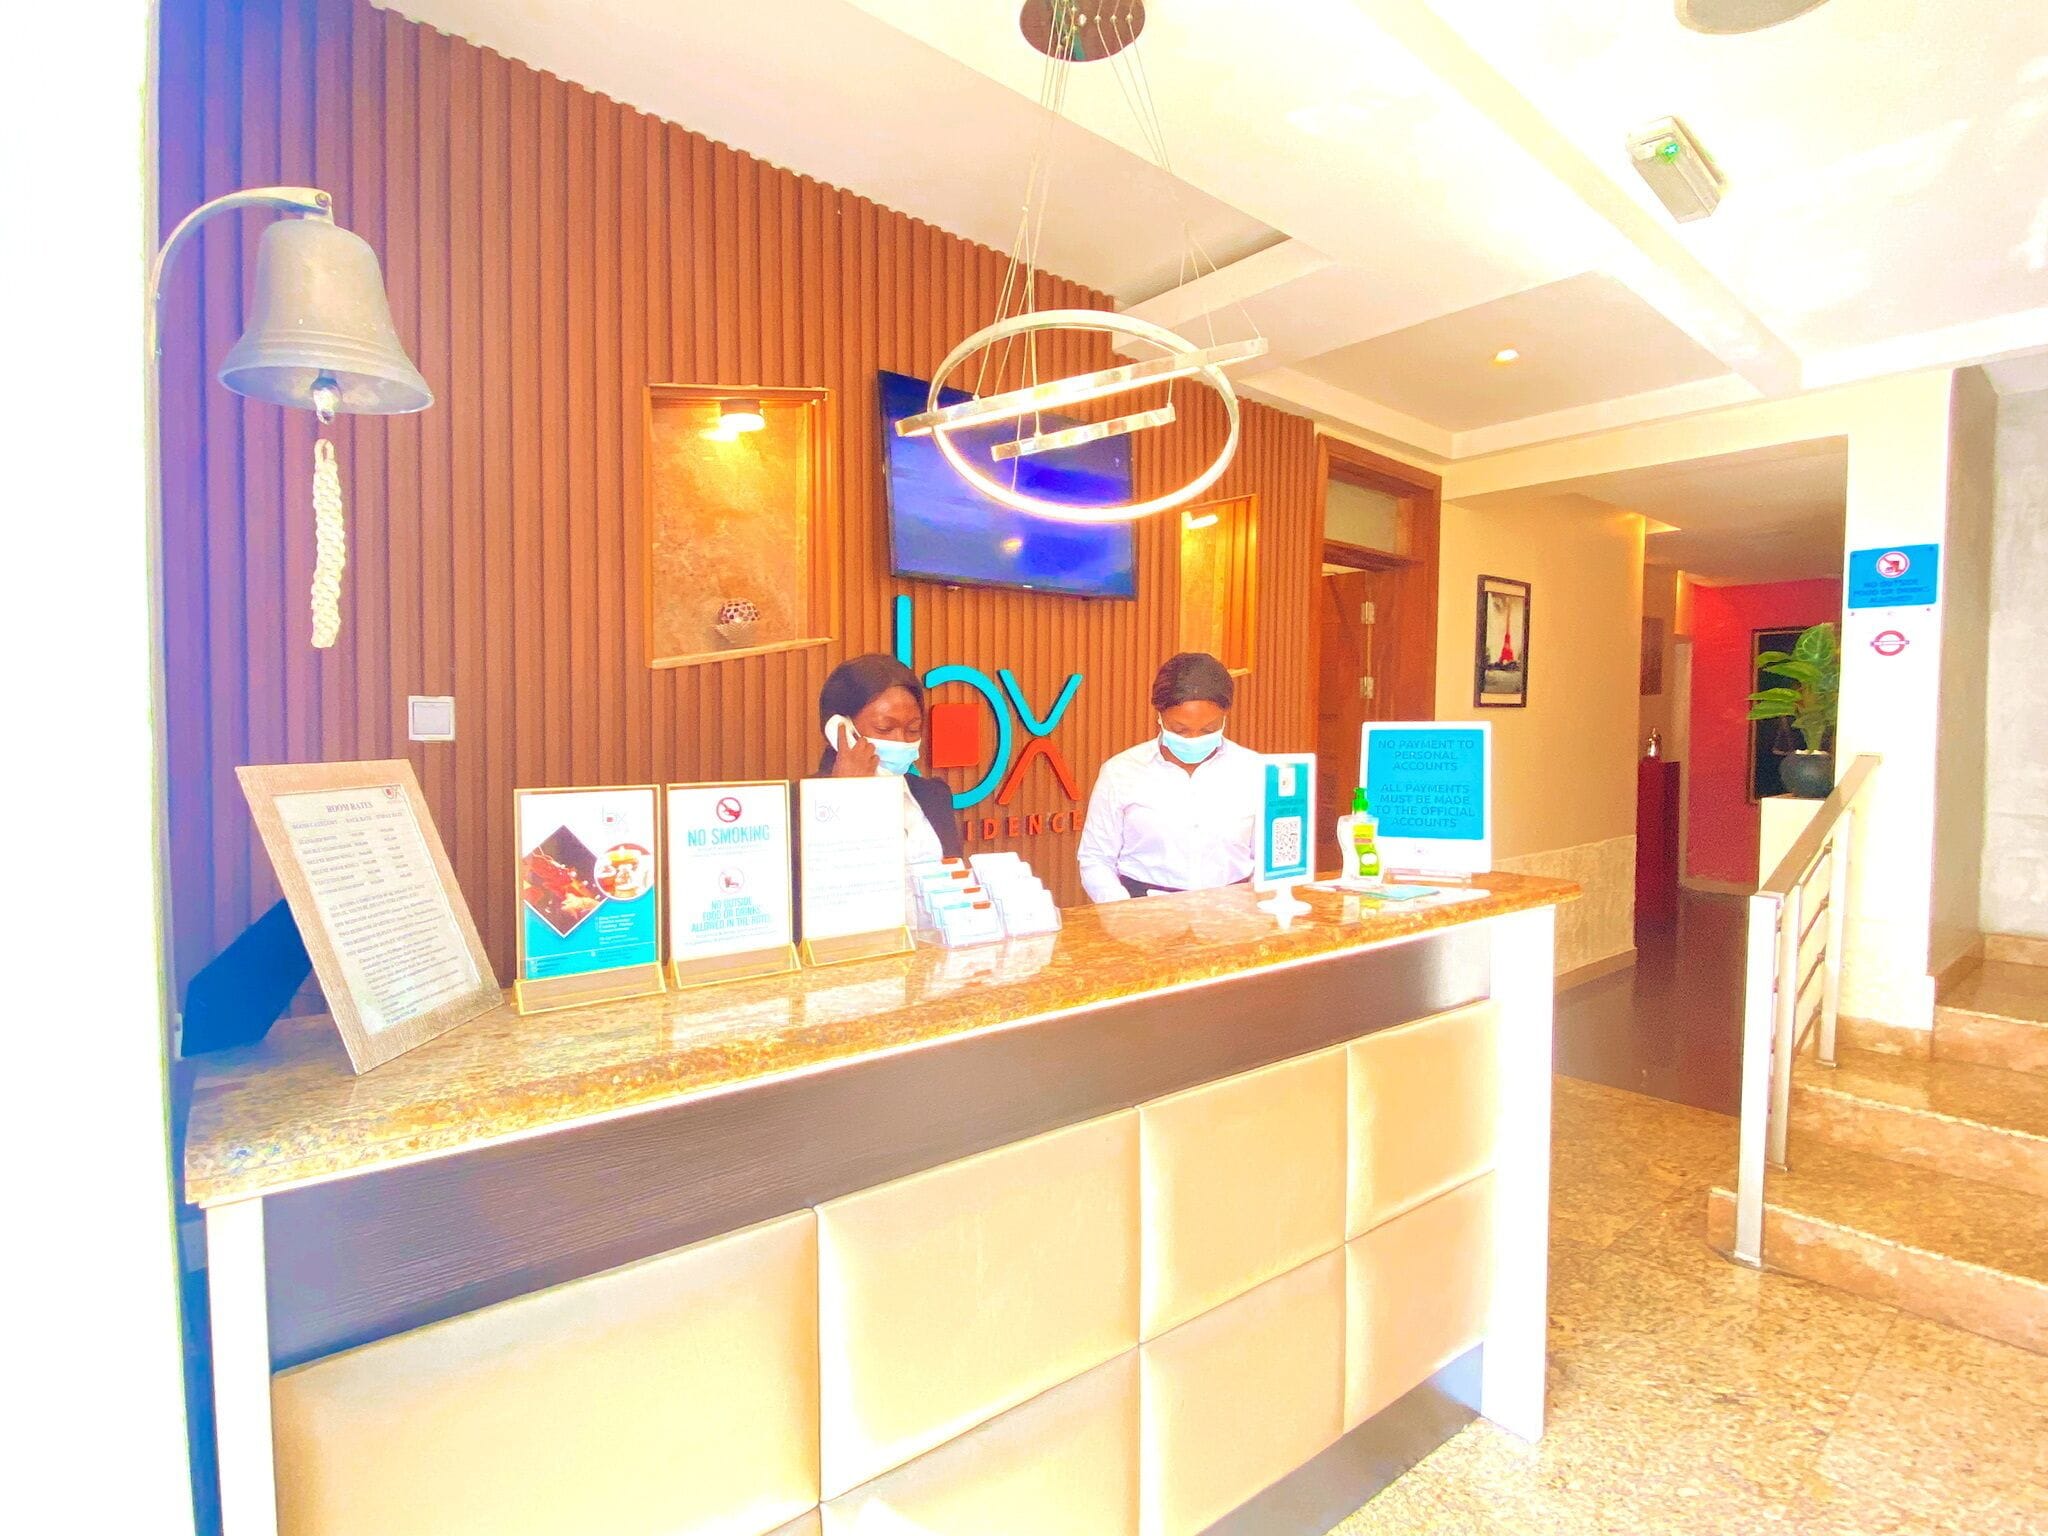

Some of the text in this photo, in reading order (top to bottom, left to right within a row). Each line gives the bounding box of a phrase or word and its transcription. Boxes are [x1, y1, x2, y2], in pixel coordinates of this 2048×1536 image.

[1378, 740, 1475, 750] NO PAYMENT TO
[1394, 750, 1458, 760] PERSONAL
[1392, 761, 1458, 772] ACCOUNTS
[1381, 783, 1471, 794] ALL PAYMENTS
[1380, 794, 1470, 805] MUST BE MADE
[1374, 804, 1476, 817] TO THE OFFICIAL
[965, 809, 1084, 842] IDENCE
[1391, 816, 1458, 828] ACCOUNTS
[687, 824, 770, 847] NO SMOKING
[711, 899, 722, 911] NO
[691, 919, 725, 933] ALLOWED
